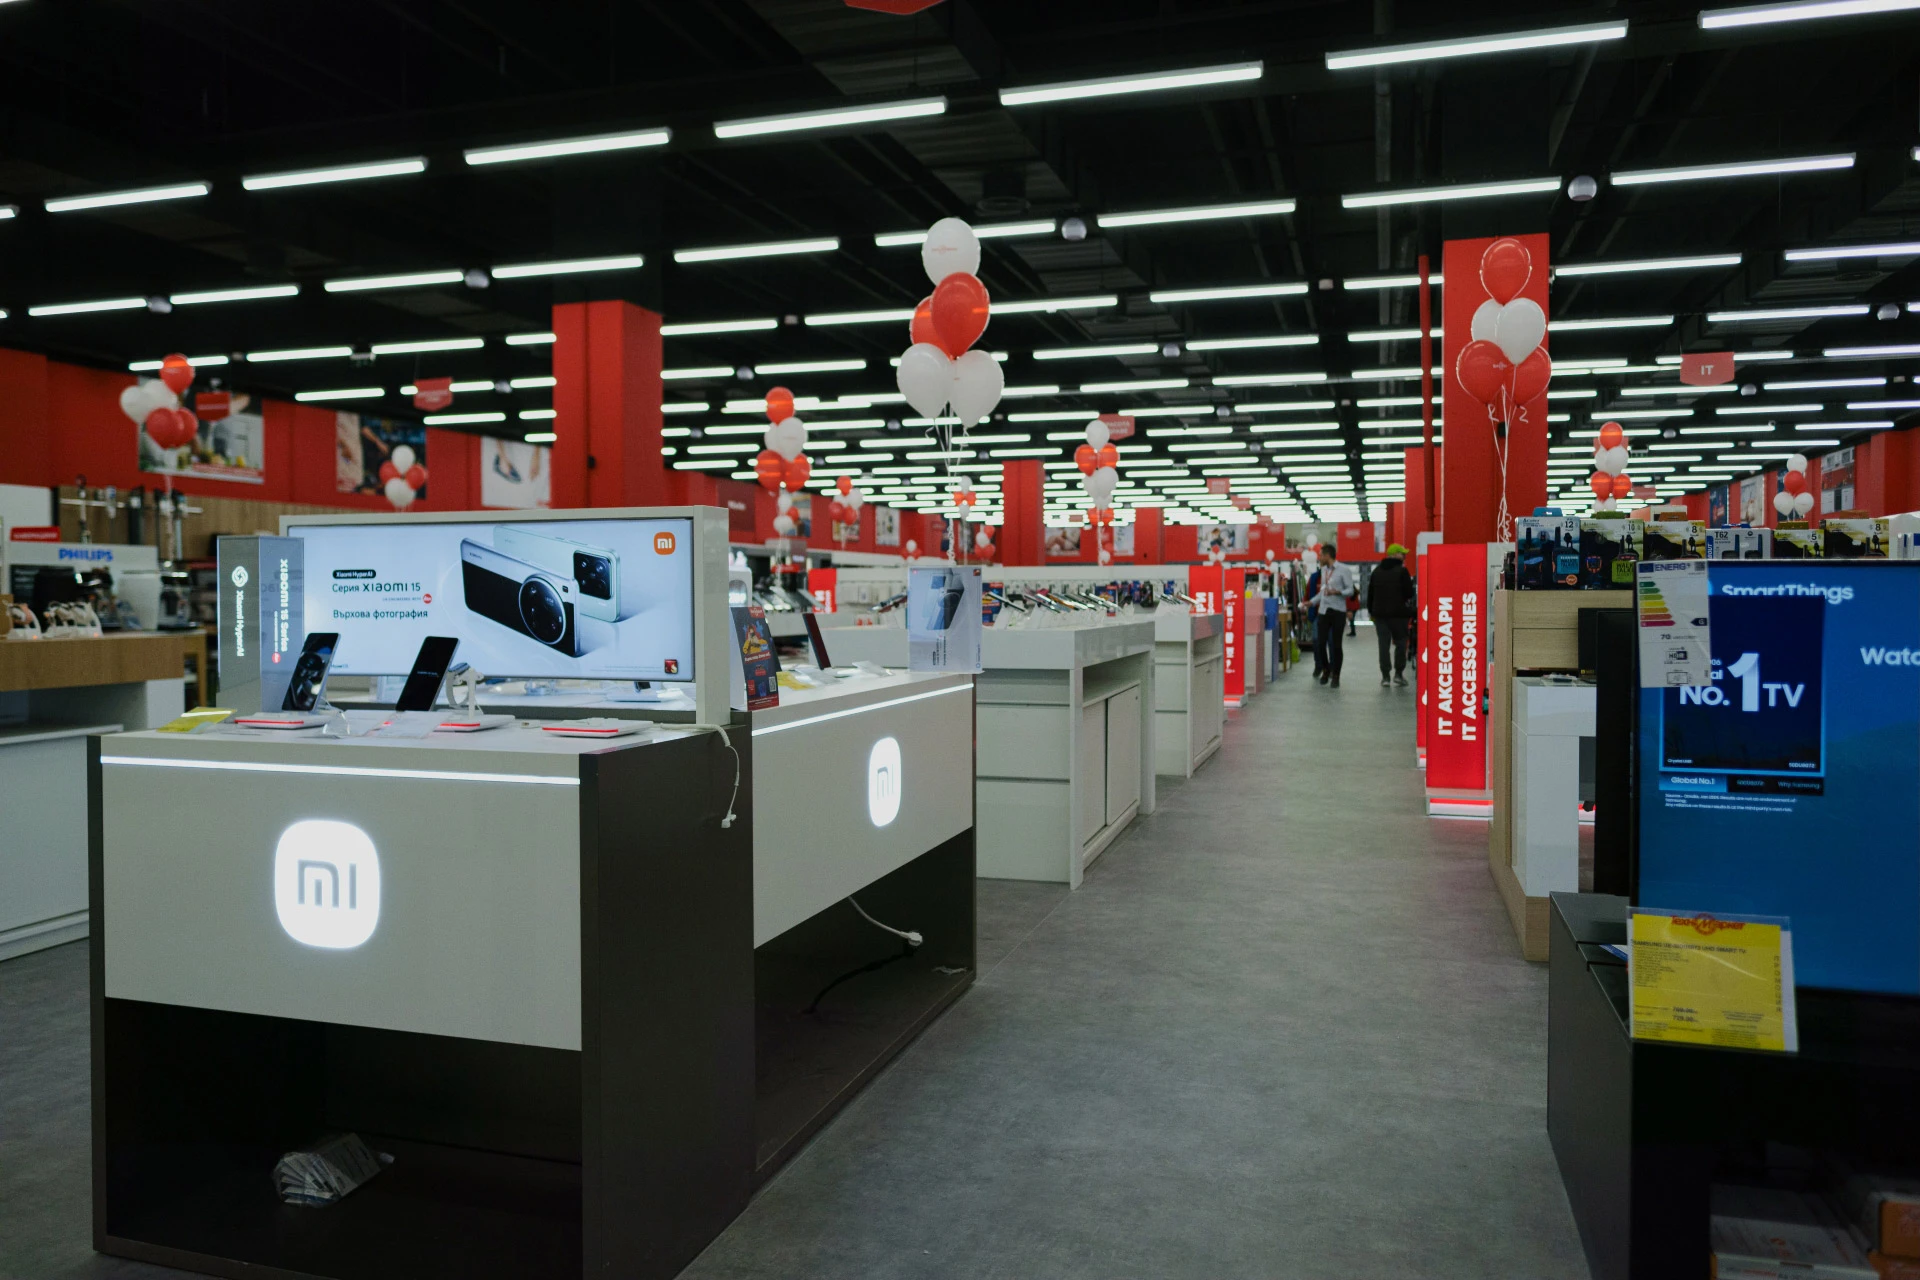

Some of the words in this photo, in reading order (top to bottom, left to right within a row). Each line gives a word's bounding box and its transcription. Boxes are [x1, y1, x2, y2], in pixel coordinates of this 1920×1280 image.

[1701, 365, 1714, 375] IT
[59, 548, 113, 561] PHILIPS
[1655, 563, 1686, 571] ENERG
[332, 584, 359, 593] Серия
[411, 583, 421, 592] 15
[1722, 584, 1854, 604] SmartThings
[281, 609, 288, 620] 15
[333, 609, 370, 620] Върхова
[373, 609, 428, 620] фотография
[281, 621, 289, 652] Series
[1438, 597, 1452, 713] АКСЕСОАРИ
[1462, 592, 1476, 719] ACCESSORIES
[1680, 686, 1730, 706] No.
[1727, 653, 1759, 711] 1
[1762, 684, 1804, 707] TV
[1462, 722, 1476, 740] IT
[1671, 776, 1697, 784] Global
